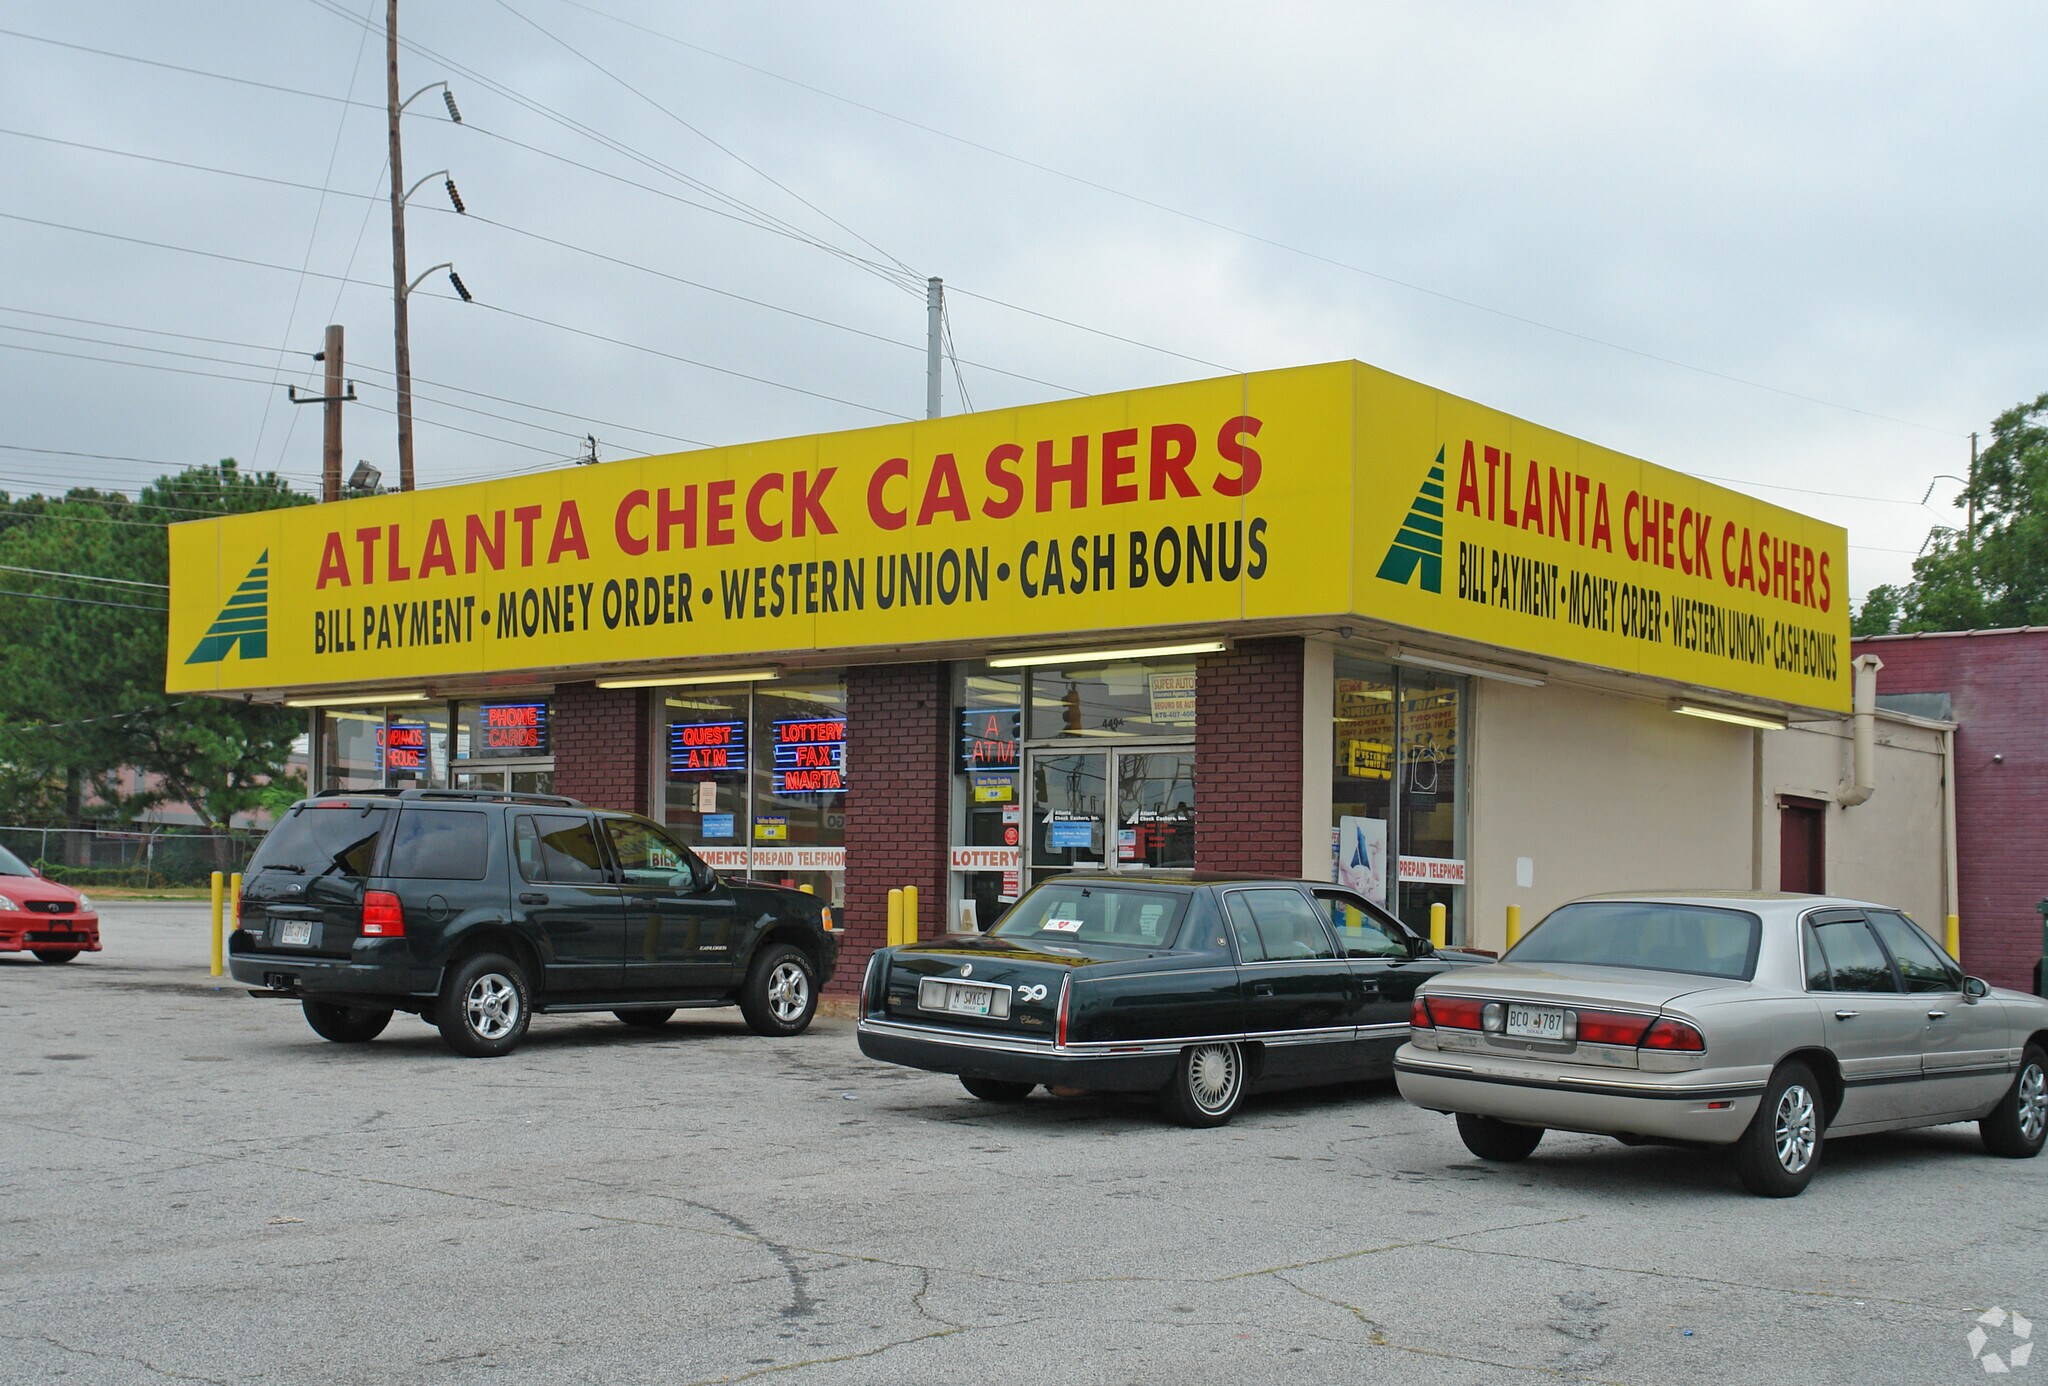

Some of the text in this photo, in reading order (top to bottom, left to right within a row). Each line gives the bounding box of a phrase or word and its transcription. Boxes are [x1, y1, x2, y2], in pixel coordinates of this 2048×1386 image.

[316, 415, 1264, 590] ATLANTA CHECK CASHERS
[1456, 440, 1831, 613] ATLANTA CHECK CASHERS
[315, 517, 1268, 655] BILL PAYMENT MONEY ORDER WESTERN UNION CASH BONUS
[1458, 540, 1838, 682] BILL PAYMENT MONEY ORDER WESTERN UNION CASH BONUS
[1175, 677, 1195, 689] AUTO
[1184, 700, 1195, 708] AUT
[488, 707, 538, 726] PHONE
[984, 714, 999, 738] A
[488, 728, 538, 747] CARDS
[683, 726, 732, 746] QUEST
[781, 722, 845, 743] LOTTERY
[688, 749, 727, 768] ATM
[796, 746, 831, 767] FAX
[971, 740, 1014, 765] ATM
[785, 770, 841, 790] MARTA
[695, 851, 748, 866] YMENTS
[753, 851, 794, 866] PREPAID
[952, 851, 1019, 866] LOTTERY
[1400, 860, 1464, 880] PREPAID TELEPHONE
[1537, 1013, 1562, 1031] 1787
